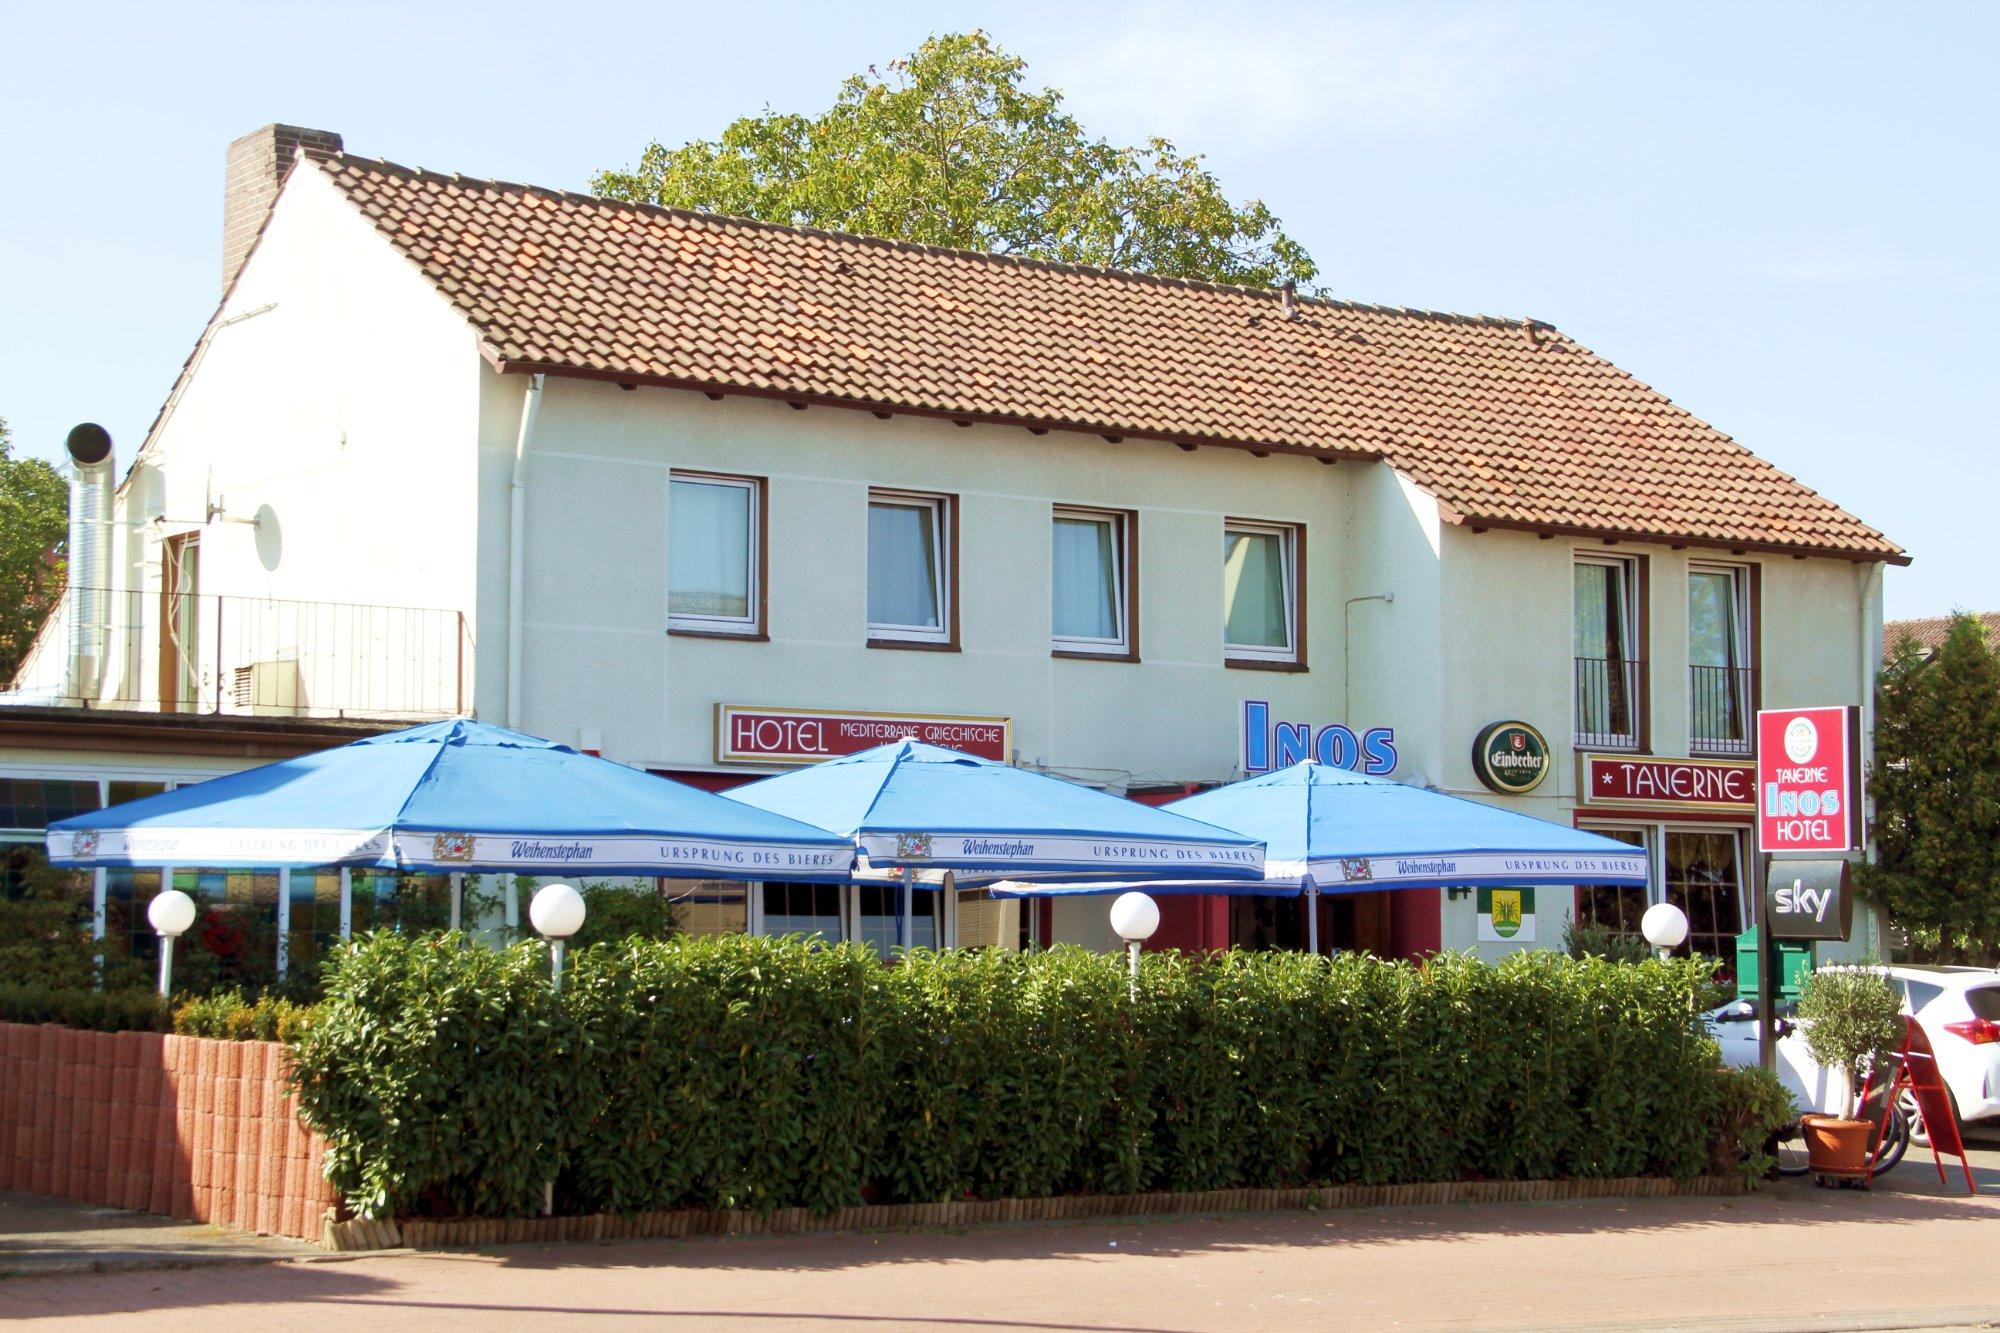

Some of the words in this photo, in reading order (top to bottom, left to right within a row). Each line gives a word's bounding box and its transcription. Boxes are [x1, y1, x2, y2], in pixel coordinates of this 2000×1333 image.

[737, 718, 829, 752] HOTEL
[840, 722, 920, 739] MEDITERRANE
[925, 726, 1000, 743] GRIECHISCHE
[1620, 764, 1745, 800] TAVERNE
[1776, 767, 1828, 783] TAVERNE
[1777, 820, 1832, 841] HOTEL
[511, 840, 592, 861] Weihenstephan
[660, 846, 744, 863] URSPRUNG
[753, 852, 779, 864] DES
[788, 854, 834, 865] BIERES
[962, 839, 1034, 857] Weihenstephan
[1093, 846, 1168, 859] URSPRUNG
[1177, 850, 1201, 859] DES
[1209, 850, 1255, 862] BIERES
[1396, 859, 1456, 875] Weihenstephan
[1505, 860, 1569, 870] URSPRUNG
[1575, 860, 1596, 870] DES
[1602, 860, 1639, 872] BIERES
[1775, 879, 1831, 922] sky
